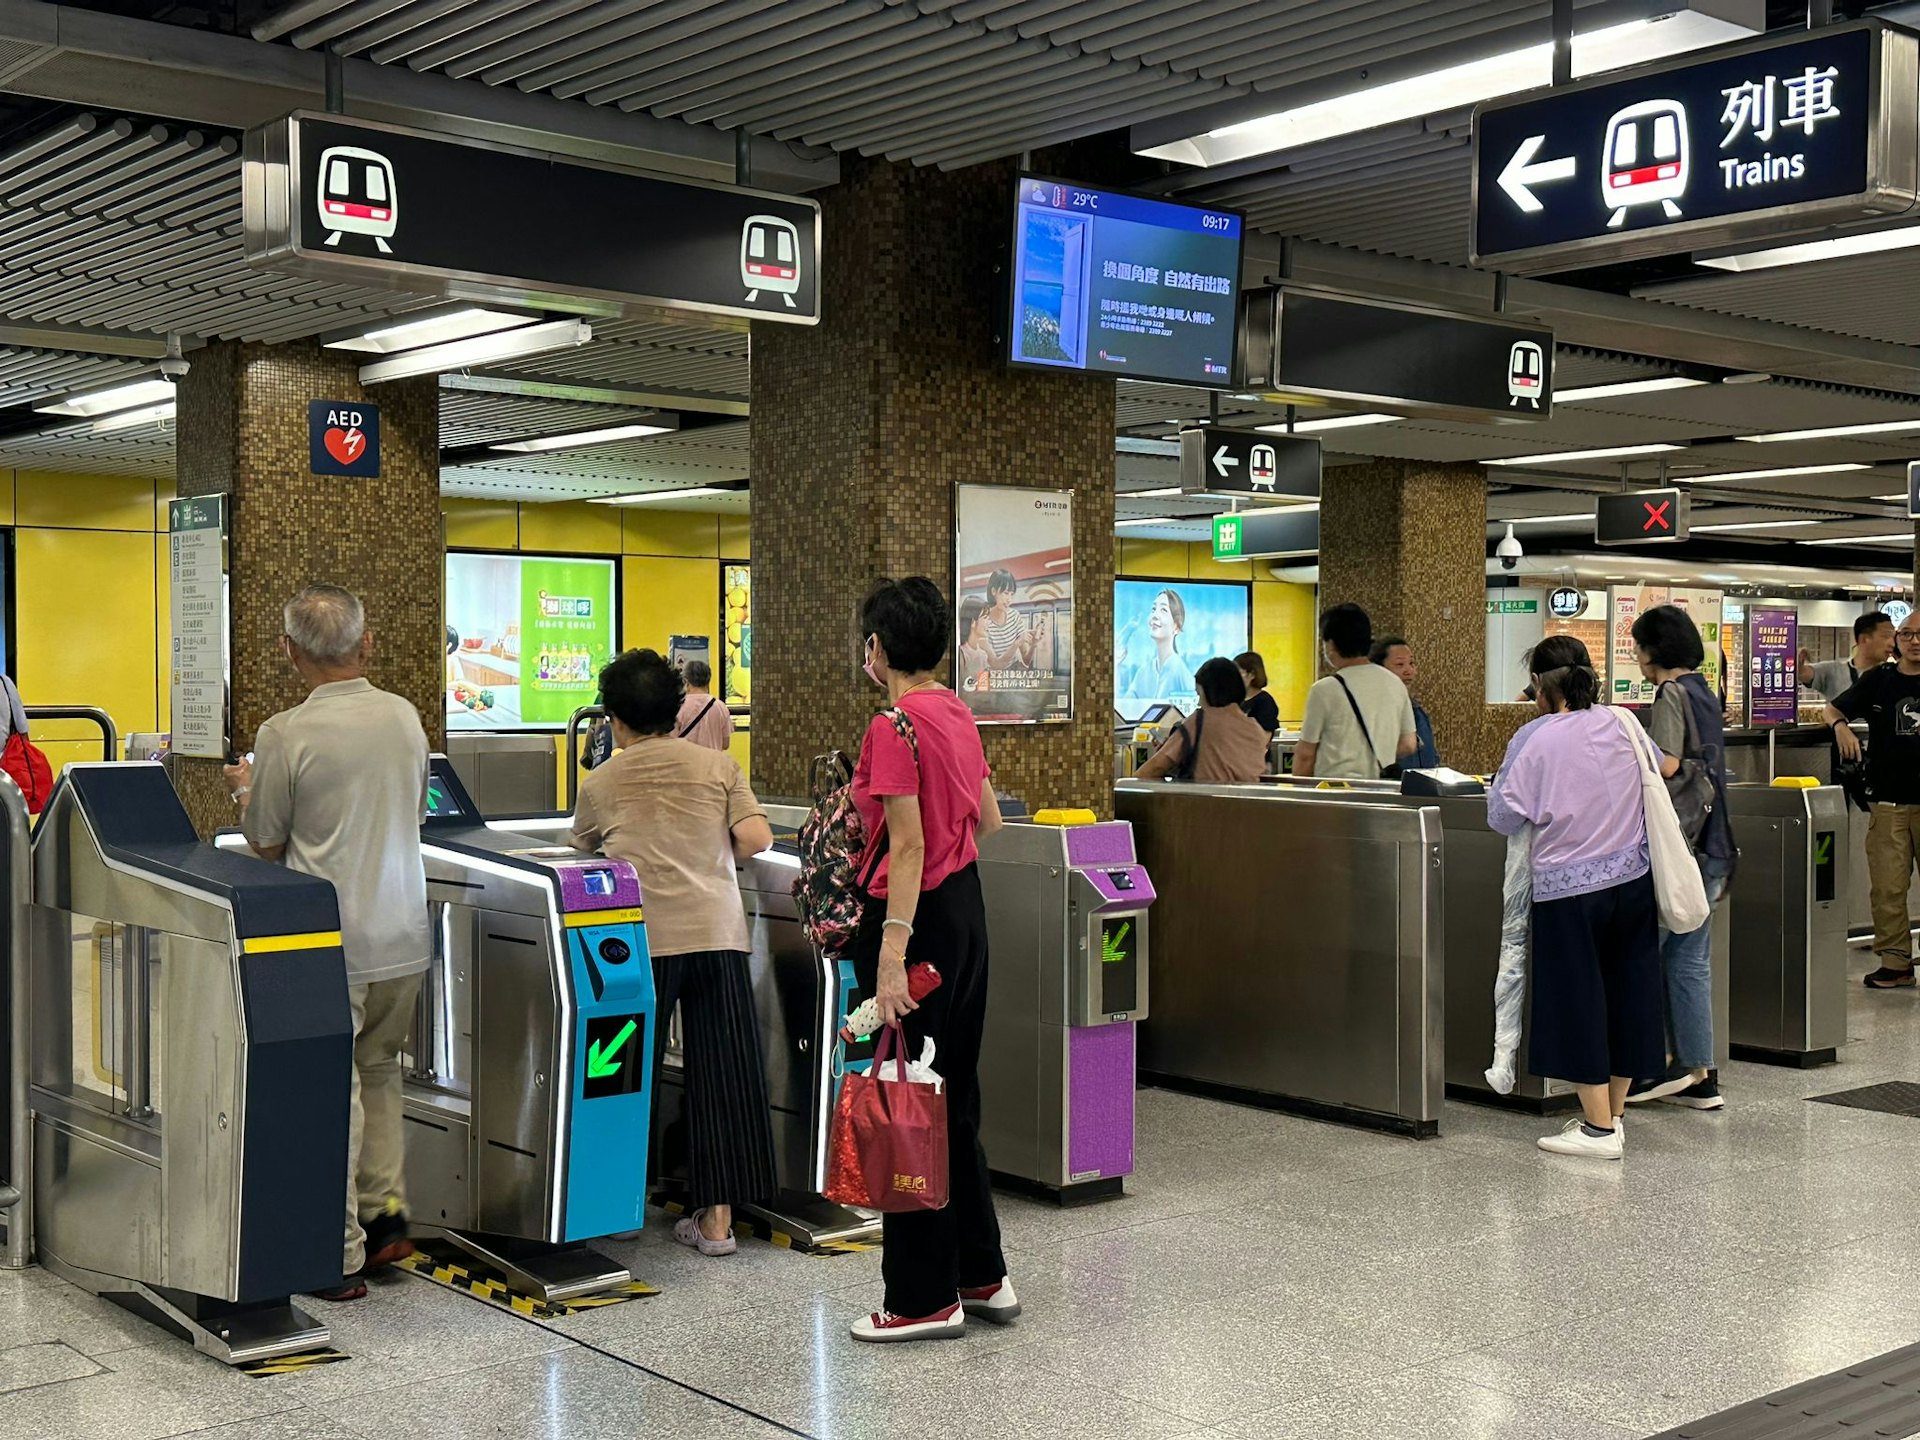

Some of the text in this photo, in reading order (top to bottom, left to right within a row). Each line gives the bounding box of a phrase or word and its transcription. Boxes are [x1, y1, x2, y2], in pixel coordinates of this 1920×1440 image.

[1718, 65, 1841, 149] 列車
[1718, 151, 1805, 190] Trains
[1073, 192, 1098, 209] 29°C
[1202, 214, 1230, 231] 09:17
[1163, 269, 1231, 296] 自然有出路
[327, 410, 363, 427] AED
[1219, 522, 1237, 543] 出
[1219, 542, 1236, 552] EXIT
